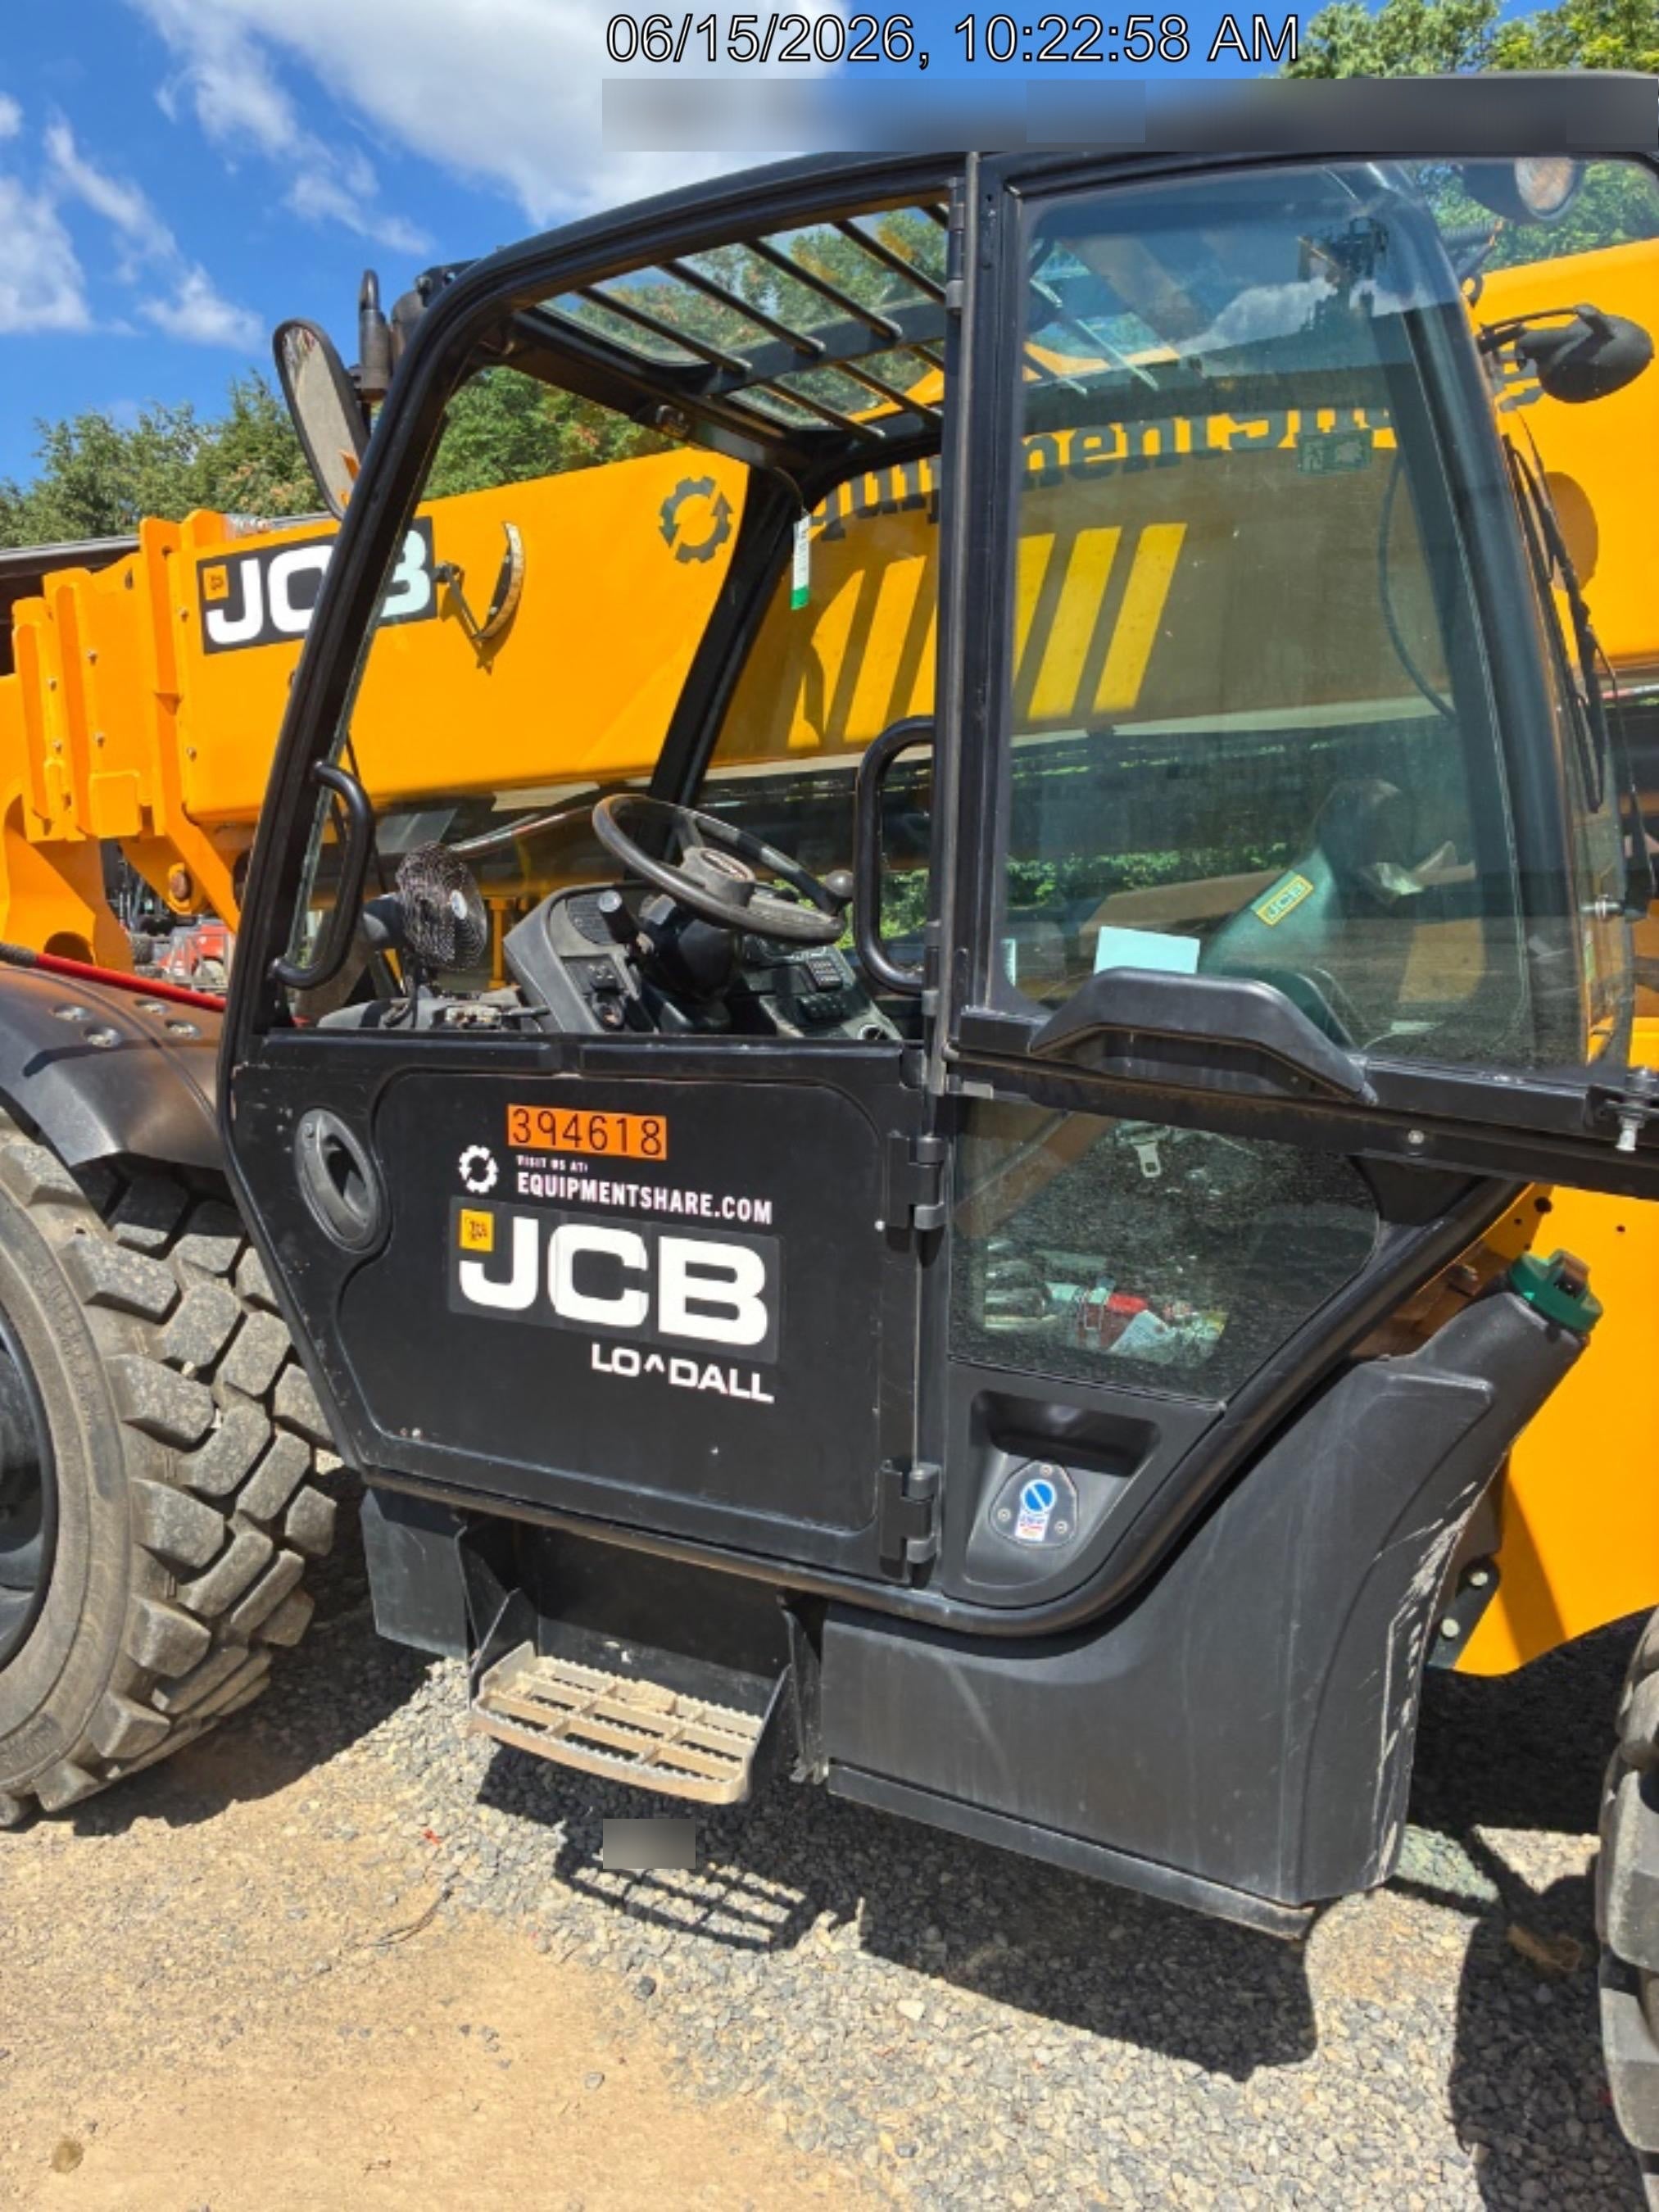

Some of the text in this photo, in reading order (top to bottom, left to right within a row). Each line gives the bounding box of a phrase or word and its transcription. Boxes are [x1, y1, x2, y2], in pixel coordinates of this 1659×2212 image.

[512, 1108, 662, 1156] 394618
[517, 1172, 773, 1226] EQUIPMENTSHARE.COM
[459, 1216, 768, 1345] JCB
